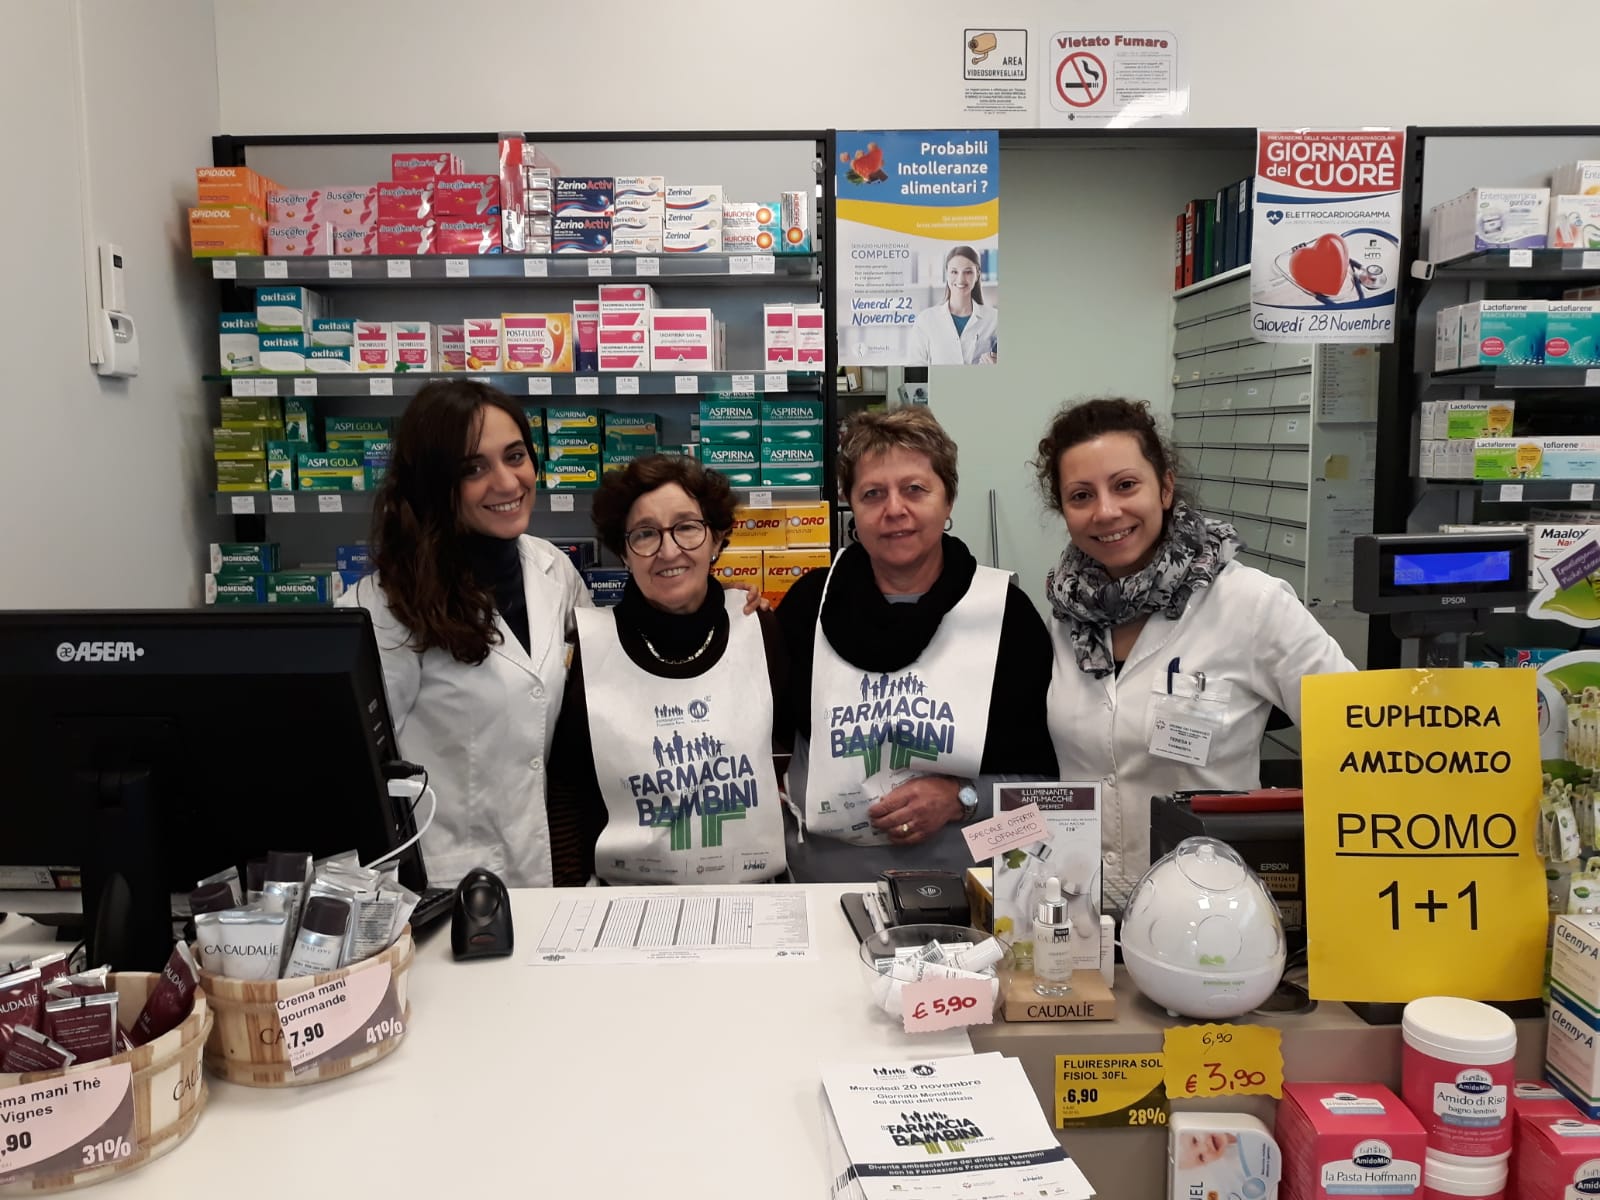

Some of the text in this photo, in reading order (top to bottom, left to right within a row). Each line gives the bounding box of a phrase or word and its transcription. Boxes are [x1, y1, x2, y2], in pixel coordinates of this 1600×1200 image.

[1057, 35, 1169, 49] Vietato Fumare
[1002, 56, 1023, 66] AREA
[967, 68, 1025, 77] VIDEOSORVEGLIATA
[921, 141, 988, 156] Probabili
[1266, 142, 1395, 162] GIORNATA
[898, 162, 988, 175] Intolleranze
[1266, 163, 1395, 186] del CUORE
[557, 180, 613, 191] ZerinoActiv
[667, 188, 692, 196] Zerinol
[900, 180, 988, 195] alimentari ?
[1285, 211, 1391, 219] ELETTROCARDIOGRAMMA
[554, 219, 610, 230] ZerinoActiv
[333, 230, 368, 240] uscofen
[665, 231, 691, 239] Zerinol
[851, 249, 910, 259] COMPLETO
[895, 297, 913, 309] 22
[851, 311, 916, 327] Novembre
[1308, 314, 1328, 332] 28
[1329, 312, 1391, 332] Novembre
[554, 410, 586, 418] ASPIRINA
[708, 407, 753, 416] ASPIRINA
[771, 407, 814, 417] ASPIRINA
[334, 422, 354, 430] ASPI
[611, 417, 644, 425] ASPIRINA
[556, 438, 588, 446] ASPIRINA
[710, 450, 755, 459] ASPIRINA
[770, 449, 814, 459] ASPIRINA
[307, 458, 358, 467] ASPI GOLA
[554, 465, 586, 473] ASPIRINA
[1441, 596, 1466, 605] EPSON
[74, 641, 136, 662] ASEM
[831, 696, 954, 728] FARMACIA
[1346, 704, 1501, 728] EUPHIDRA
[830, 719, 955, 758] BAMBINI
[1339, 751, 1512, 774] AMIDOMIO
[628, 754, 754, 797] FARMACIA
[635, 779, 758, 827] BAMBINI
[1337, 813, 1517, 850] PROMO
[1260, 863, 1290, 871] EPSON
[1378, 880, 1478, 931] 1+1
[276, 977, 346, 1010] Crema mani
[280, 993, 347, 1026] gourmande
[912, 996, 978, 1019] € 5,90
[366, 1016, 403, 1044] 41%
[1202, 1031, 1233, 1046] 6,90
[1063, 1059, 1163, 1069] FLUIRESPIRA SOL
[1063, 1071, 1128, 1080] FISIOL 30FL
[1185, 1062, 1266, 1093] € 3,90
[920, 1079, 982, 1090] novembre
[1458, 1083, 1491, 1091] AmidoMio
[0, 1078, 101, 1110] ema mani Thè
[920, 1090, 962, 1098] Mondiale
[1437, 1091, 1505, 1106] Amido di Riso
[0, 1105, 53, 1124] Vignes
[1128, 1107, 1166, 1125] 28%
[1448, 1104, 1472, 1115] bagno
[887, 1118, 976, 1135] FARMACIA
[891, 1126, 984, 1147] BAMBINI
[82, 1135, 132, 1165] 31%
[974, 1155, 997, 1163] diritti
[998, 1153, 1011, 1161] dei
[1012, 1151, 1045, 1160] bambini
[915, 1166, 964, 1175] Fondazione
[965, 1161, 1009, 1171] Francesca
[1010, 1159, 1031, 1167] Rava
[1325, 1171, 1417, 1182] la Pasta Hoffmann
